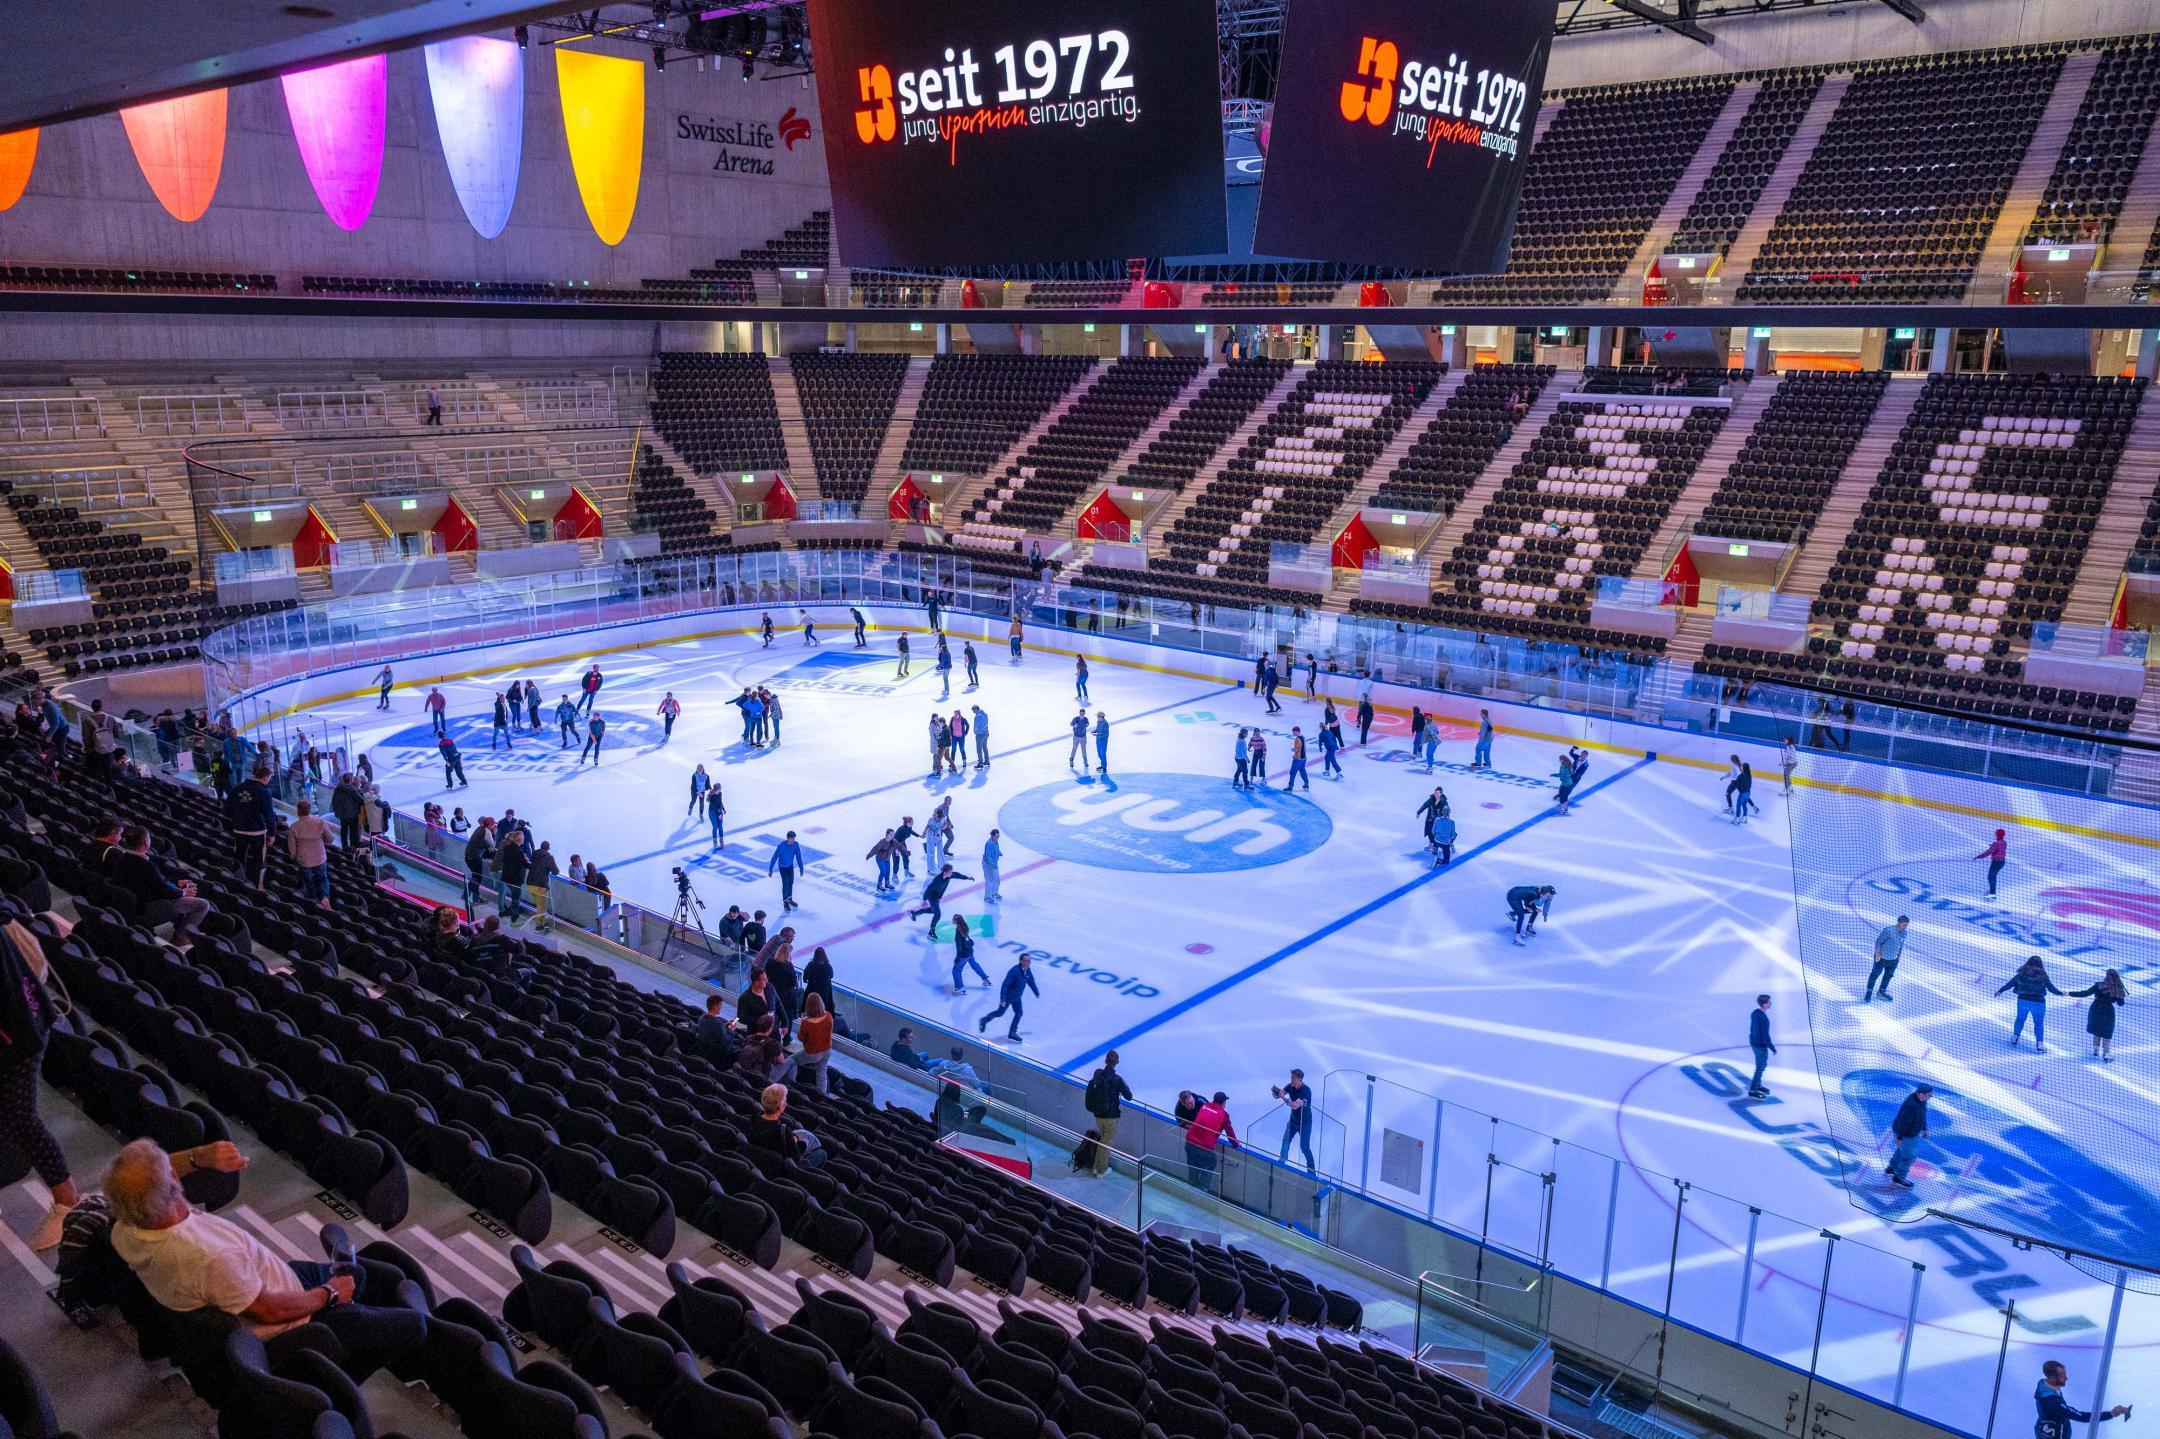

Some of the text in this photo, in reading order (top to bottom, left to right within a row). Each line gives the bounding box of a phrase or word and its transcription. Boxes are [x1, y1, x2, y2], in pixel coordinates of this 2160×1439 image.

[898, 30, 1134, 115] seit 1972
[1400, 53, 1526, 132] seit 1972
[677, 115, 774, 149] SwissLife
[903, 114, 940, 144] jung.
[1029, 91, 1141, 128] einzigartig.
[713, 148, 774, 176] Arena
[1090, 506, 1099, 515] G1
[756, 678, 898, 694] FENSTER
[1050, 783, 1292, 855] yuh
[996, 940, 1160, 998] netvoip
